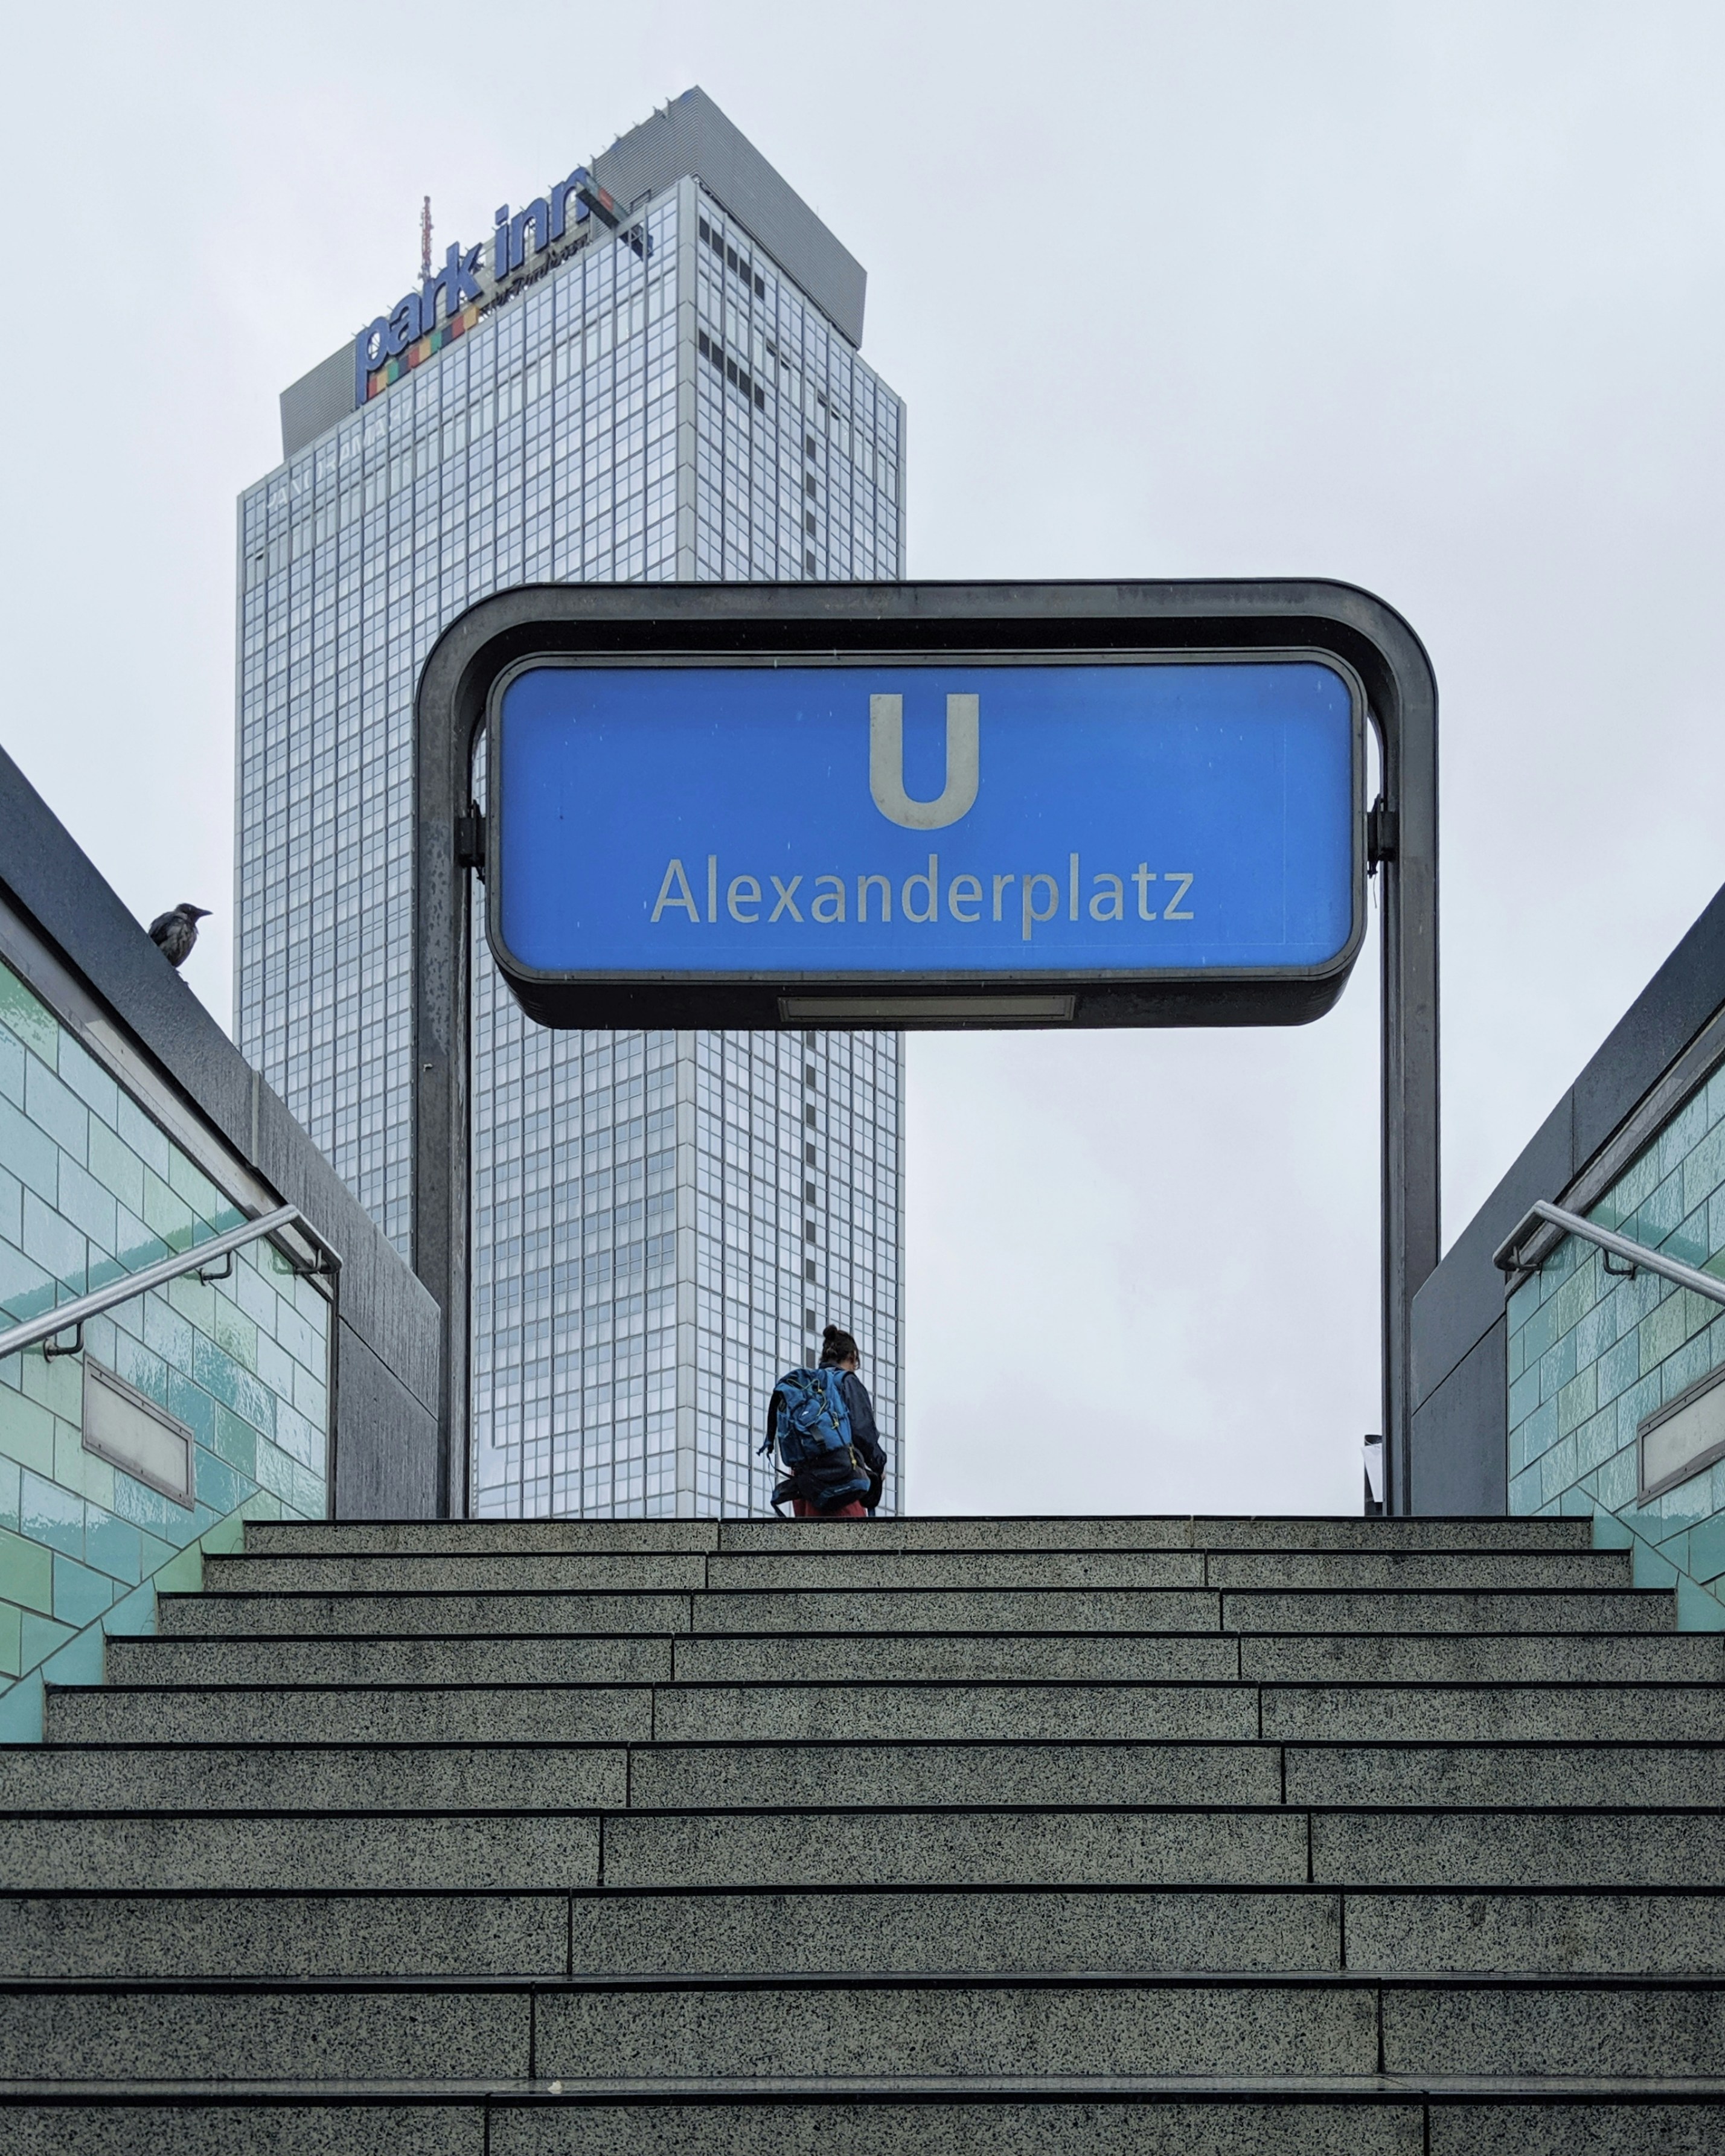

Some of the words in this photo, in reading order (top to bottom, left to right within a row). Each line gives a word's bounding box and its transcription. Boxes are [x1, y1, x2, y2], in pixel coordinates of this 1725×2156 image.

[354, 242, 483, 409] park
[494, 166, 590, 281] inn
[869, 693, 979, 830] U
[650, 852, 1195, 941] Alexanderplatz
